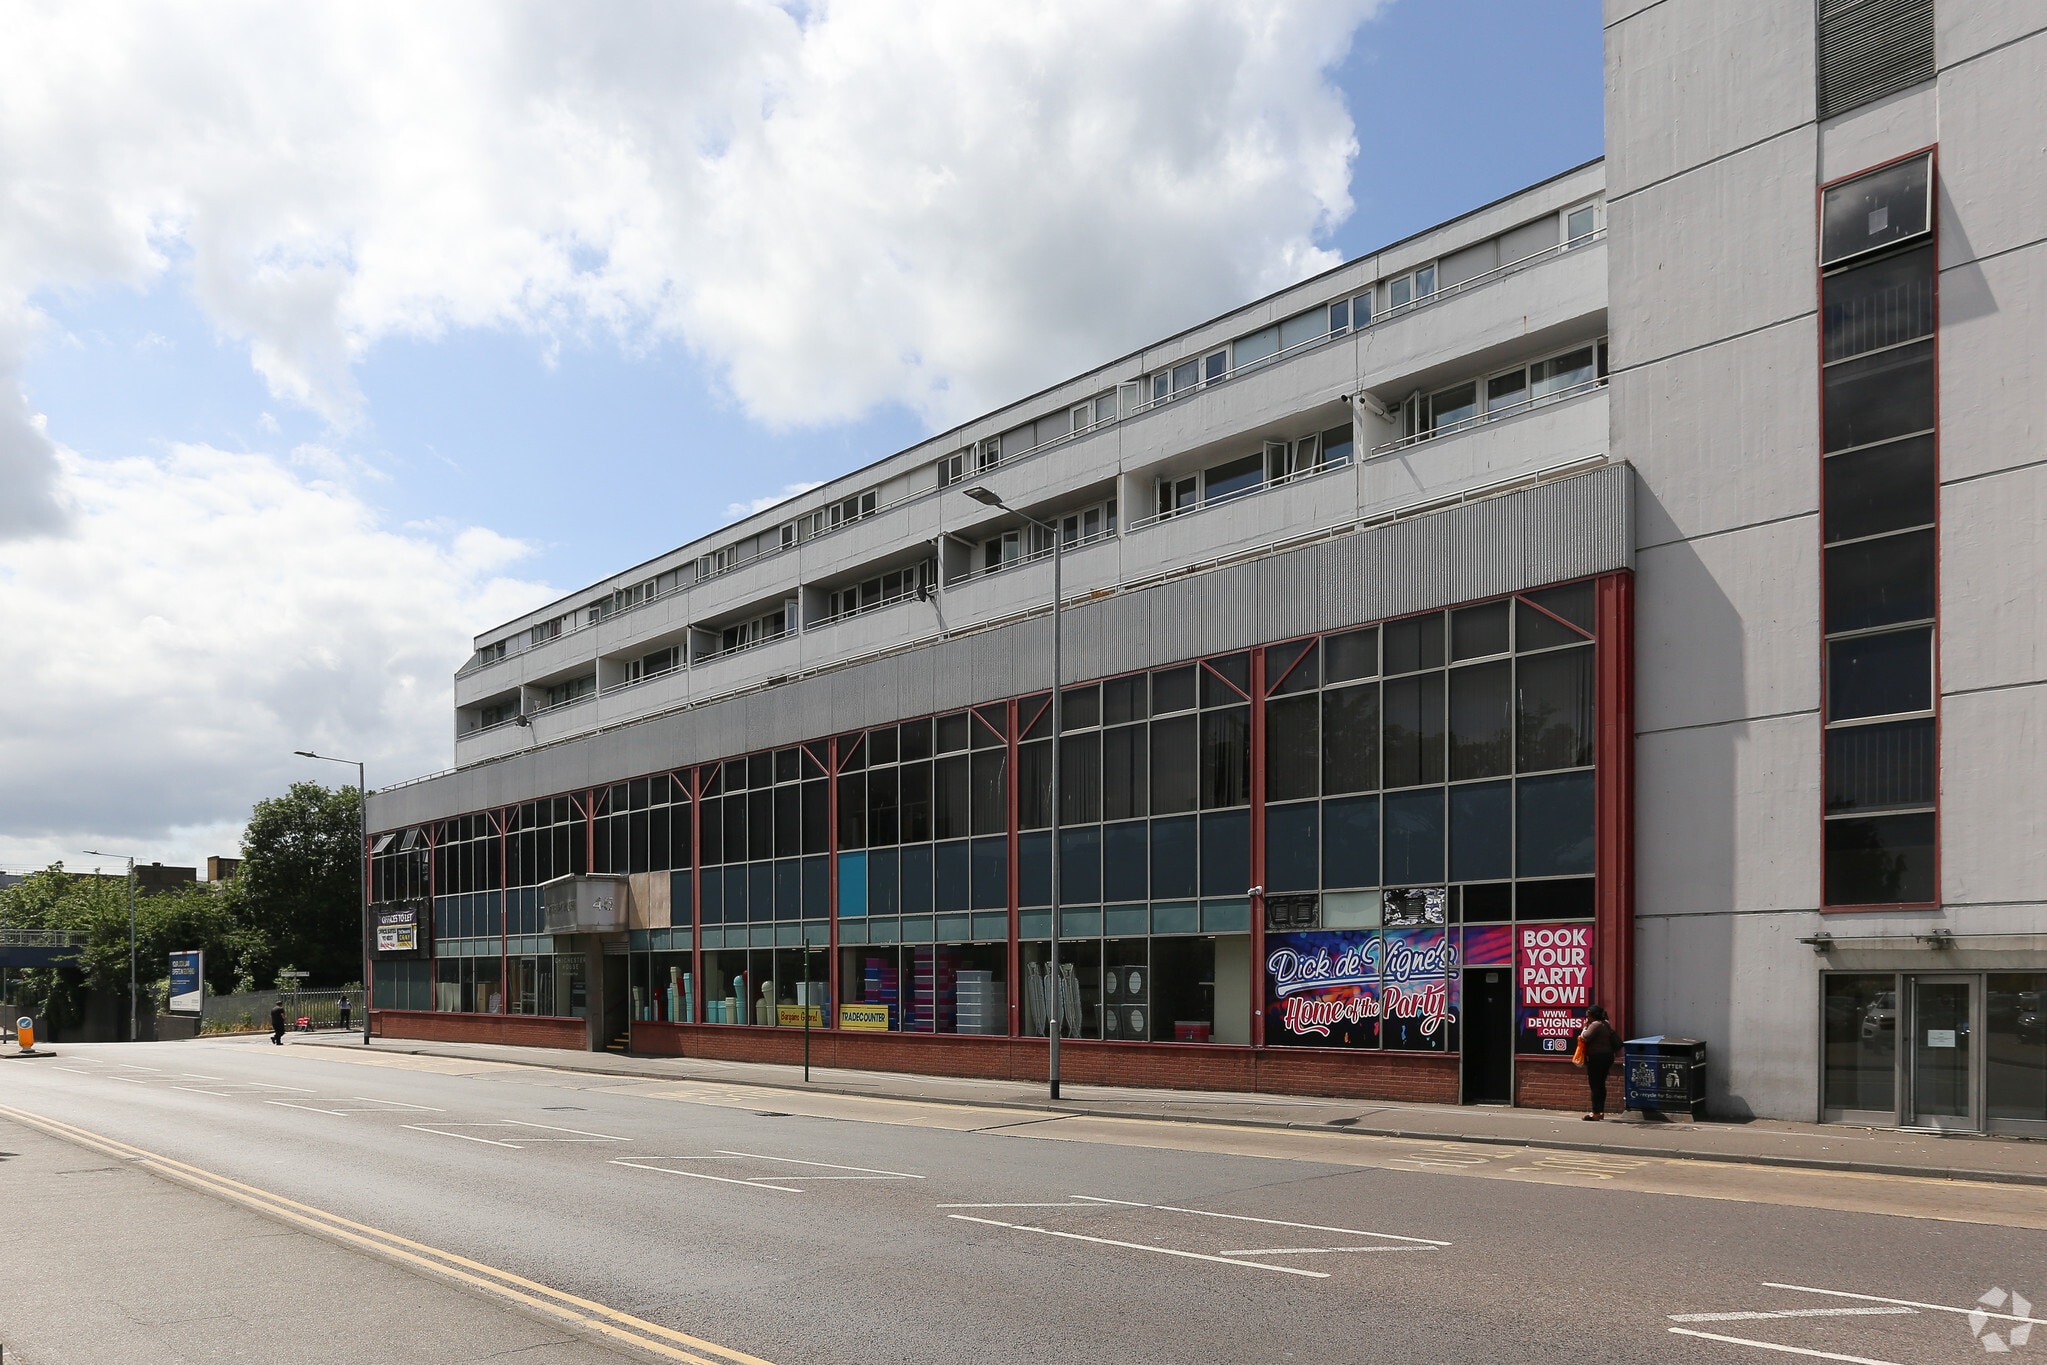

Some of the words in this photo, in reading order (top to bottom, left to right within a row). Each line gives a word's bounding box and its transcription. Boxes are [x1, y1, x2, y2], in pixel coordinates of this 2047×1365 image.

[1523, 928, 1587, 948] BOOK
[1267, 948, 1331, 984] Dick
[1335, 948, 1361, 977] de
[1526, 948, 1585, 966] YOUR
[1523, 967, 1587, 985] PARTY
[1526, 986, 1585, 1004] NOW!
[780, 1011, 800, 1023] Bargains
[800, 1011, 818, 1022] Gore!
[1285, 997, 1345, 1036] Home
[1344, 998, 1361, 1024] of
[1360, 997, 1379, 1017] the
[1382, 983, 1455, 1036] Party
[1528, 1018, 1582, 1029] DEVIGNES
[1540, 1028, 1569, 1036] .CO.UK
